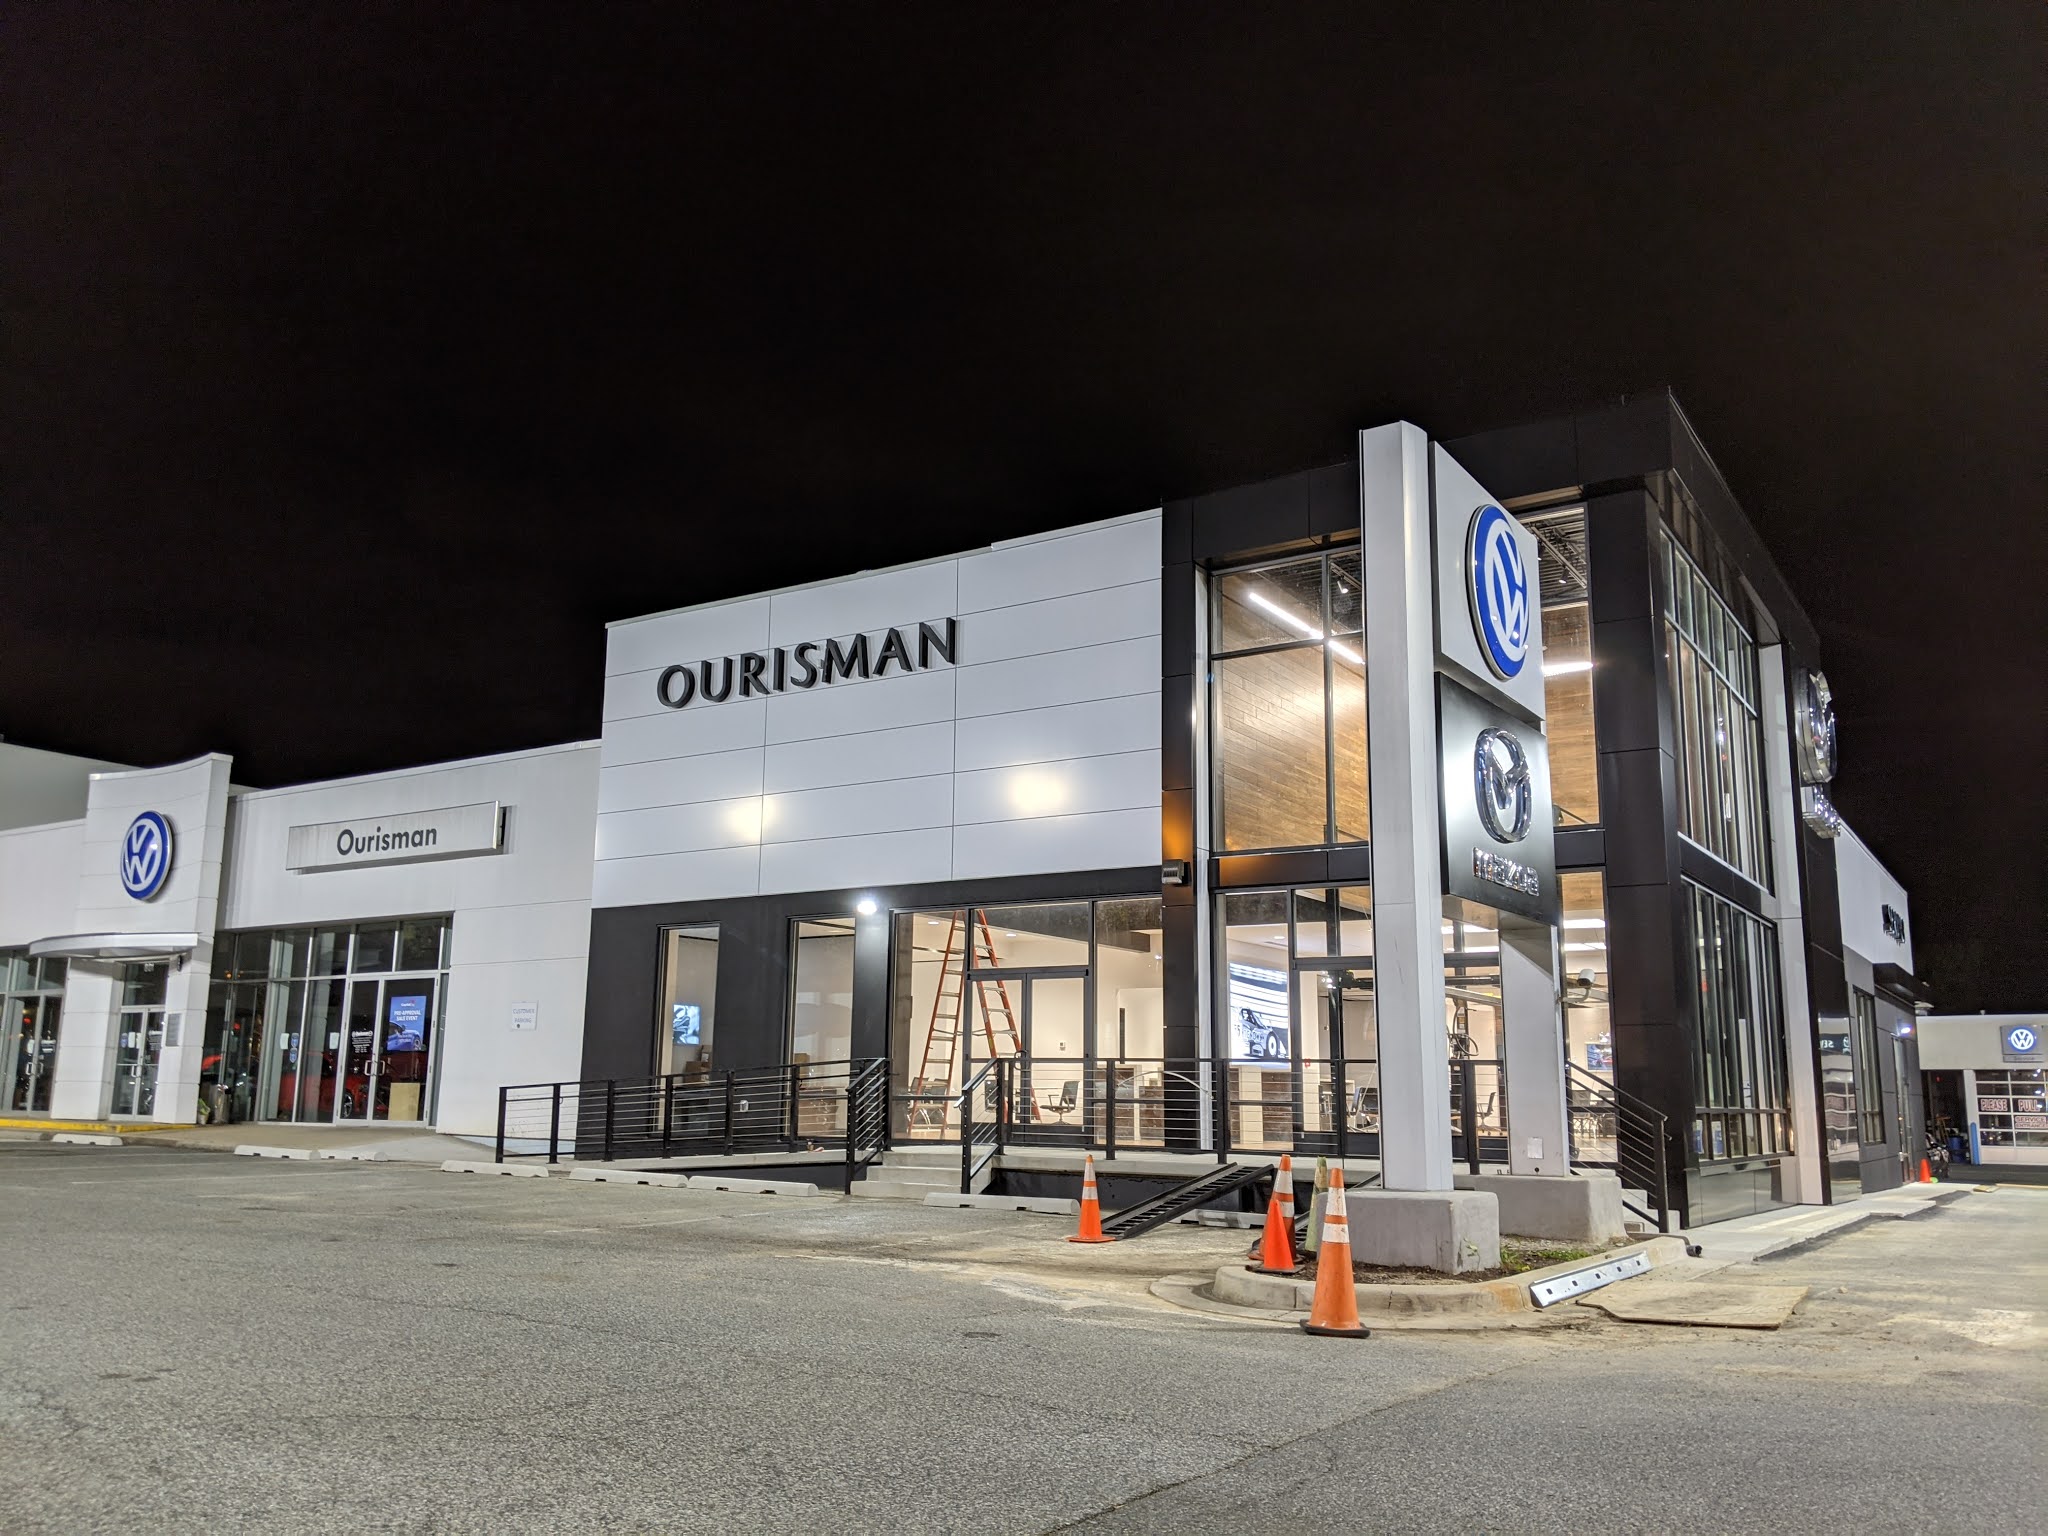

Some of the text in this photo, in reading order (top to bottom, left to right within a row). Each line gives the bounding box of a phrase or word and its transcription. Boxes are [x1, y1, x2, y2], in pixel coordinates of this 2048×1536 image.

[656, 617, 956, 709] OURISMAN
[337, 826, 437, 856] Ourisman
[1980, 1099, 2040, 1112] PLEASE PULL
